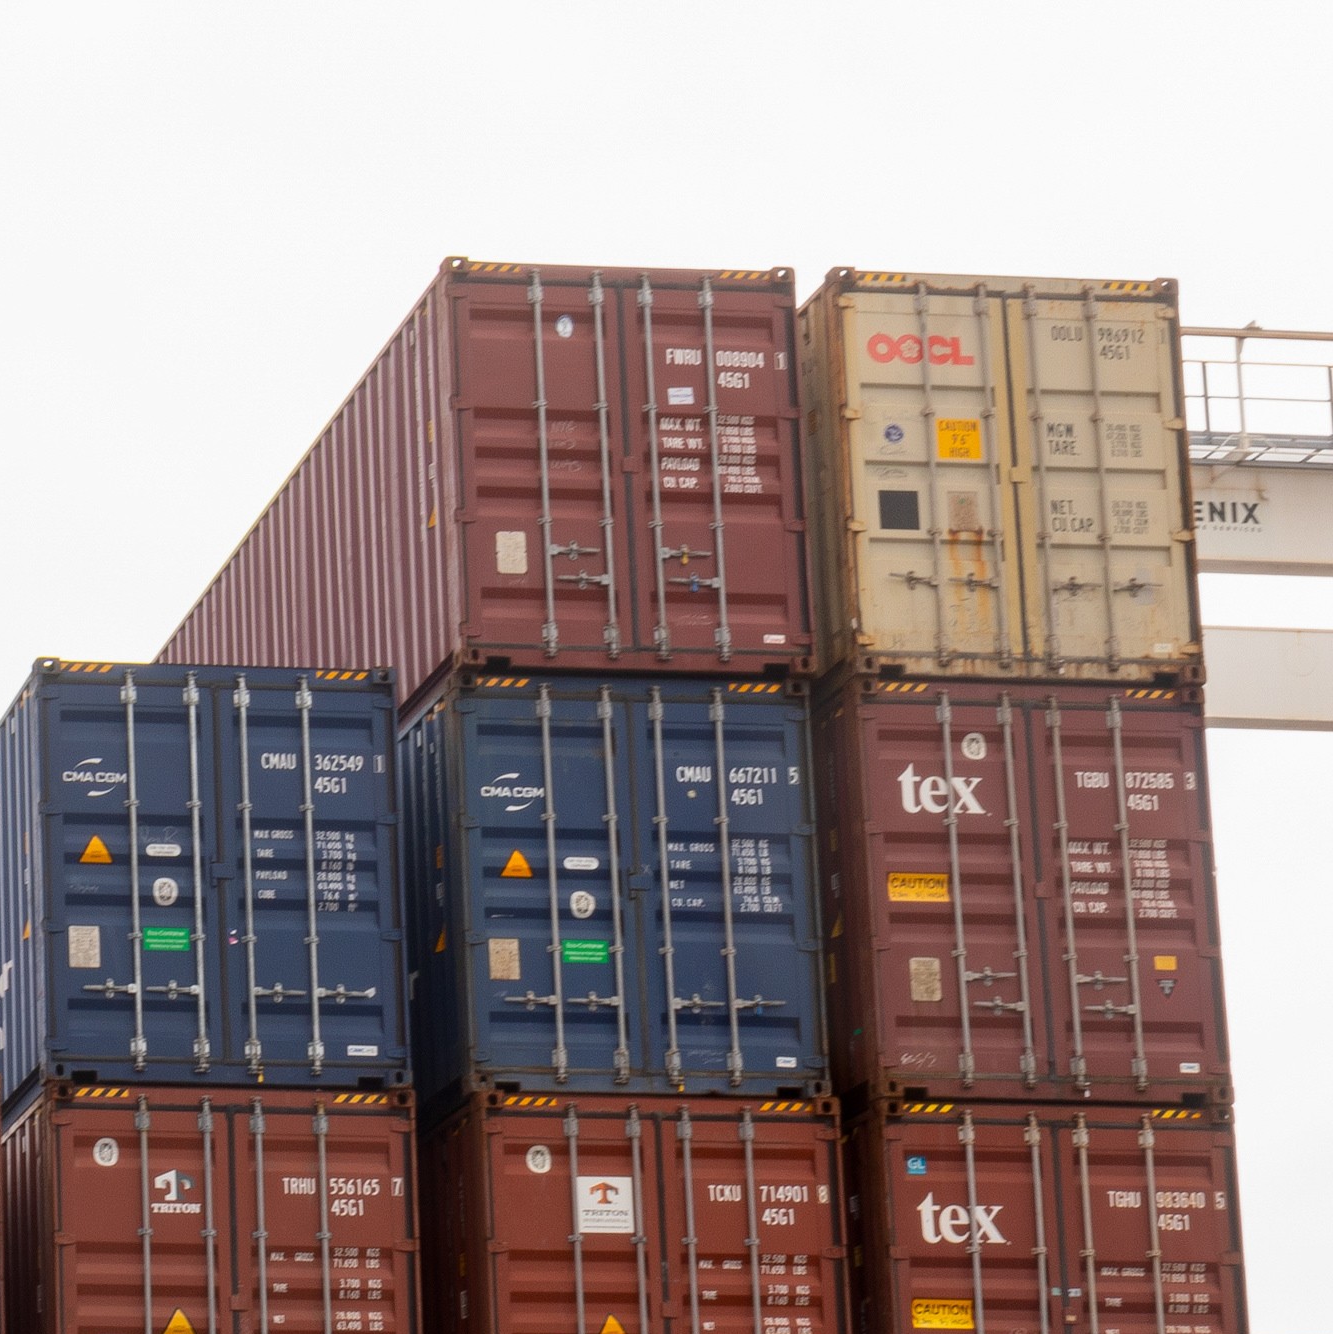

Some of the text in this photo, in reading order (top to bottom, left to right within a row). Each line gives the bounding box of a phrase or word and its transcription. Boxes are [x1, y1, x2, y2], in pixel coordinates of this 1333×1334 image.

[1051, 325, 1083, 342] OOLU
[1098, 327, 1145, 343] 986912
[666, 348, 701, 366] FWRU
[866, 333, 974, 365] OOCL
[1100, 345, 1131, 360] 45G1
[717, 372, 750, 389] 45G1
[938, 421, 977, 433] CAUTION
[949, 446, 971, 458] HIGH
[261, 753, 296, 770] CMAU
[314, 754, 363, 771] 362549
[676, 766, 798, 784] CMAU 667211 5
[1186, 773, 1196, 790] 3
[314, 777, 346, 793] 45G1
[897, 763, 986, 815] tex
[731, 789, 763, 805] 45G1
[1127, 794, 1159, 811] 45G1
[891, 876, 945, 889] CAUTION
[908, 1158, 926, 1171] GL
[283, 1178, 402, 1196] TRHU 556165 7
[708, 1185, 741, 1202] TCKU
[760, 1186, 808, 1203] 714901
[331, 1199, 364, 1216] 45G1
[1107, 1190, 1225, 1209] TGHU 983640 5
[151, 1203, 201, 1214] TRITON
[583, 1209, 628, 1217] TRITON
[762, 1208, 795, 1225] 45G1
[917, 1192, 1006, 1244] tex
[1158, 1213, 1190, 1231] 45G1
[913, 1303, 969, 1317] CAUTION
